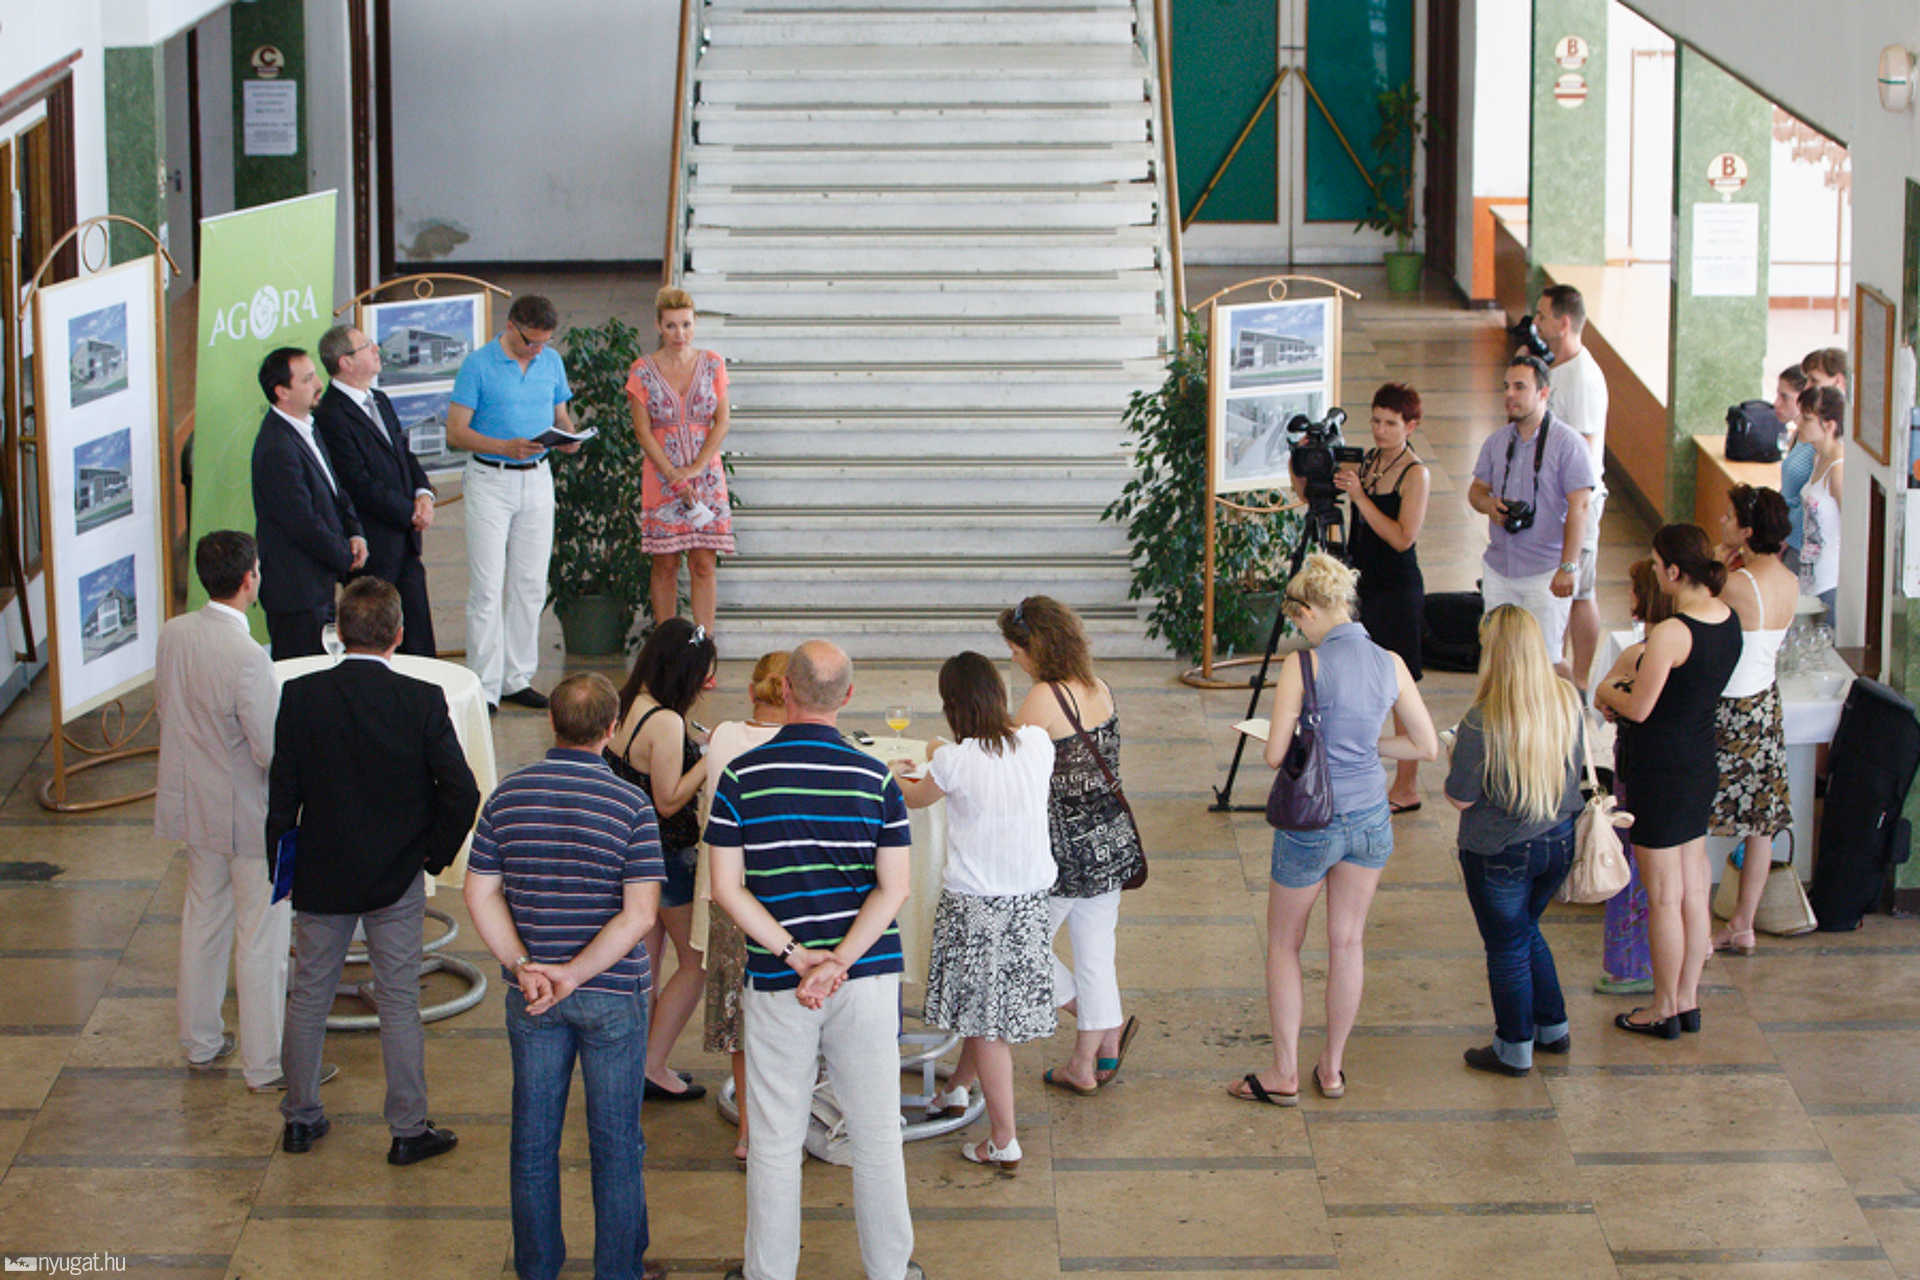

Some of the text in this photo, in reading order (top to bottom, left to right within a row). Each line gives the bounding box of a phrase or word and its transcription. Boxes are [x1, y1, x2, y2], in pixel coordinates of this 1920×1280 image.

[260, 48, 277, 66] C
[1567, 39, 1577, 56] B
[1722, 156, 1736, 177] B
[208, 284, 319, 347] AGORA
